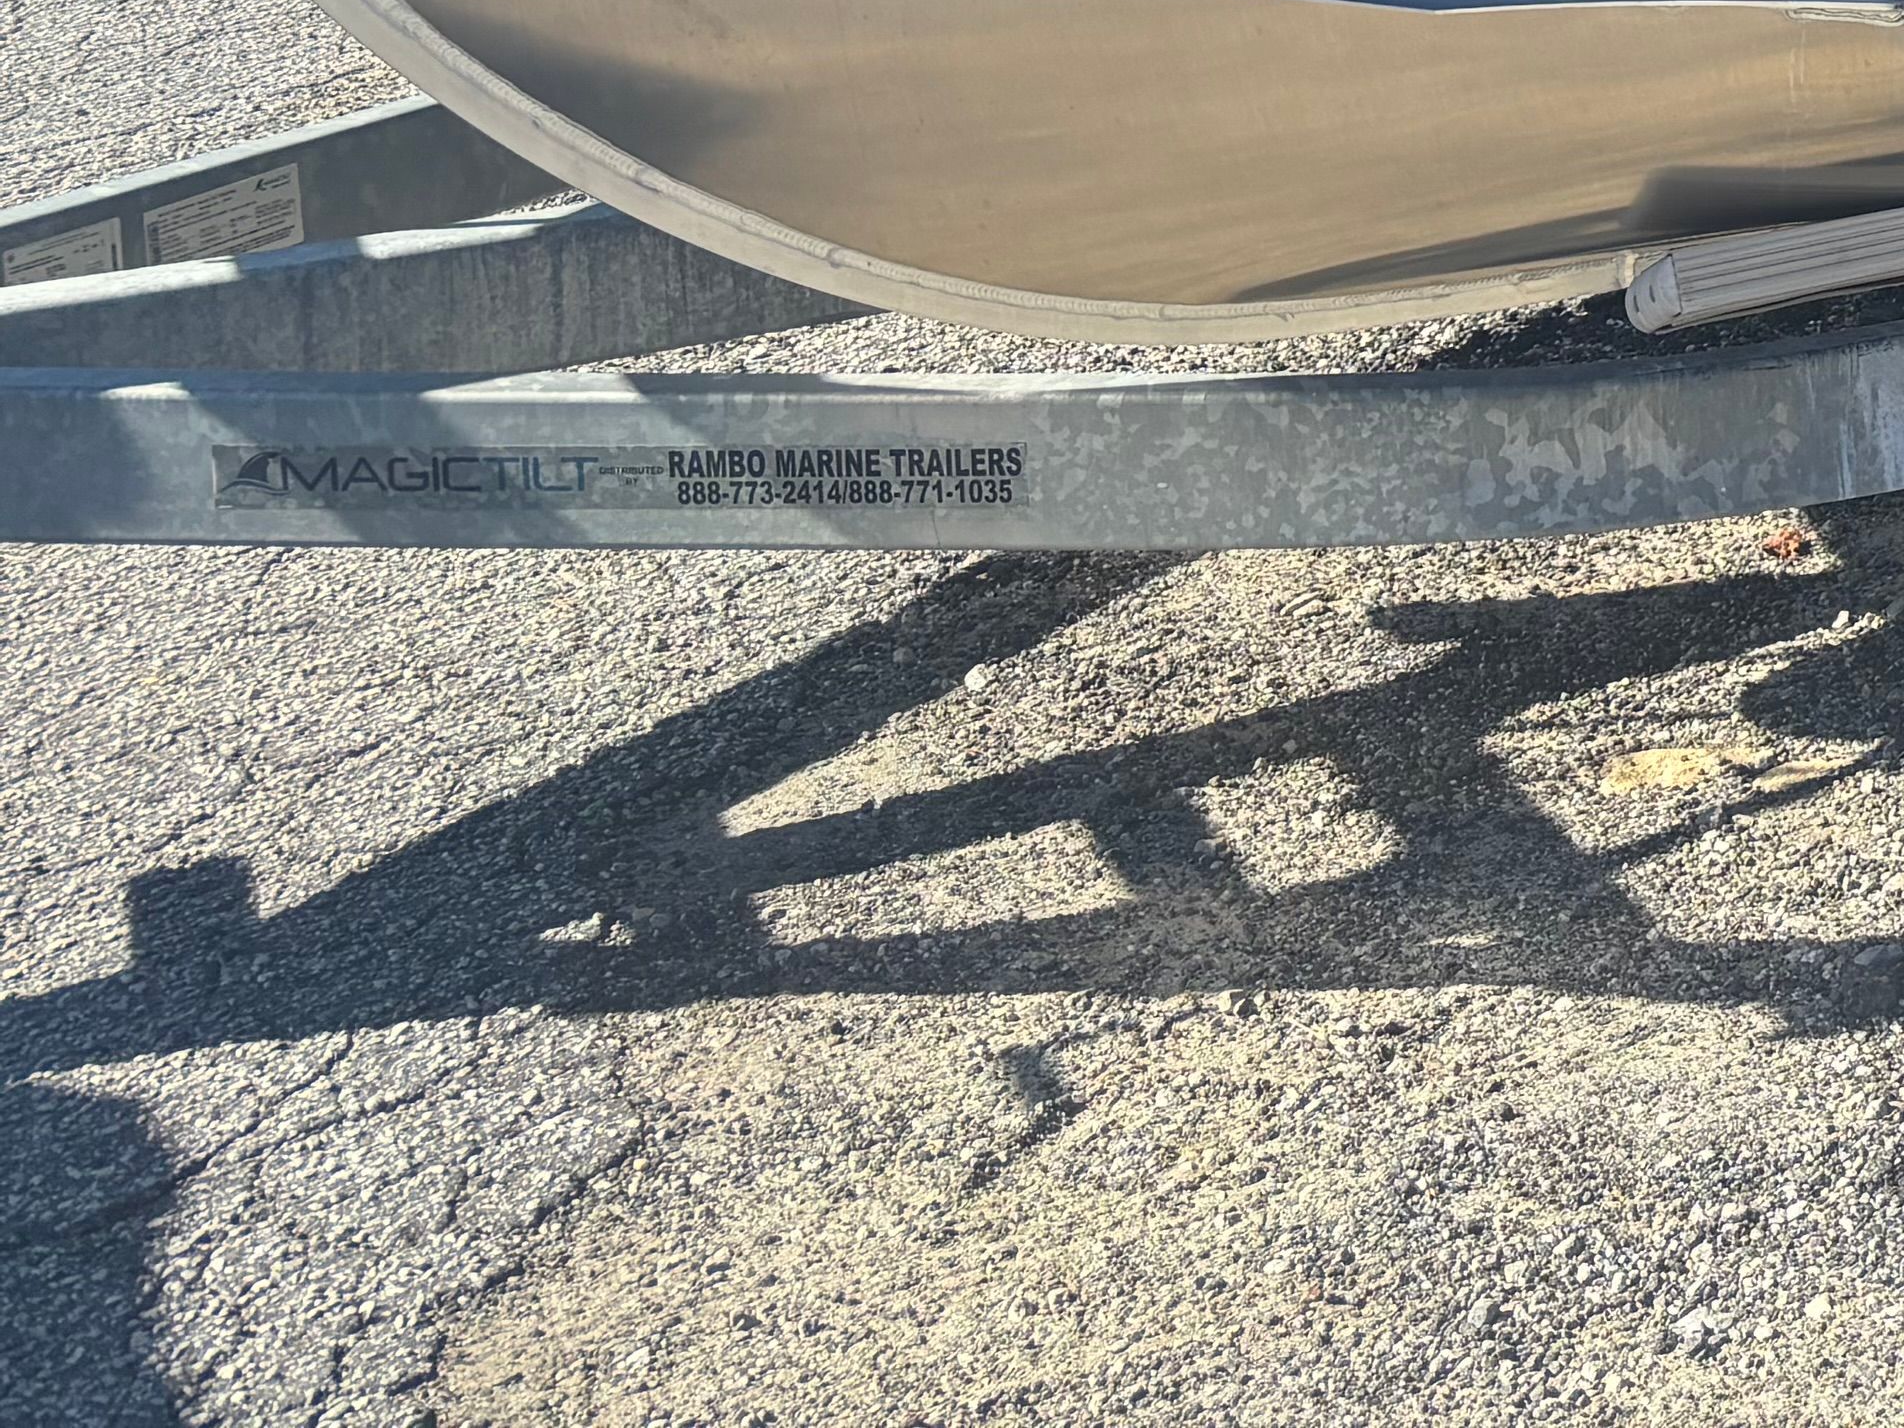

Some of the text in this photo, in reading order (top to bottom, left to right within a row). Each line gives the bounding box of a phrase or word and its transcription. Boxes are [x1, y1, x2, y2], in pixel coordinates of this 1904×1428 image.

[281, 456, 599, 492] MAGICTILT
[668, 447, 1022, 478] RAMBO MARINE TRAILERS
[677, 479, 1013, 505] 888-773-2414/888-771-1035
